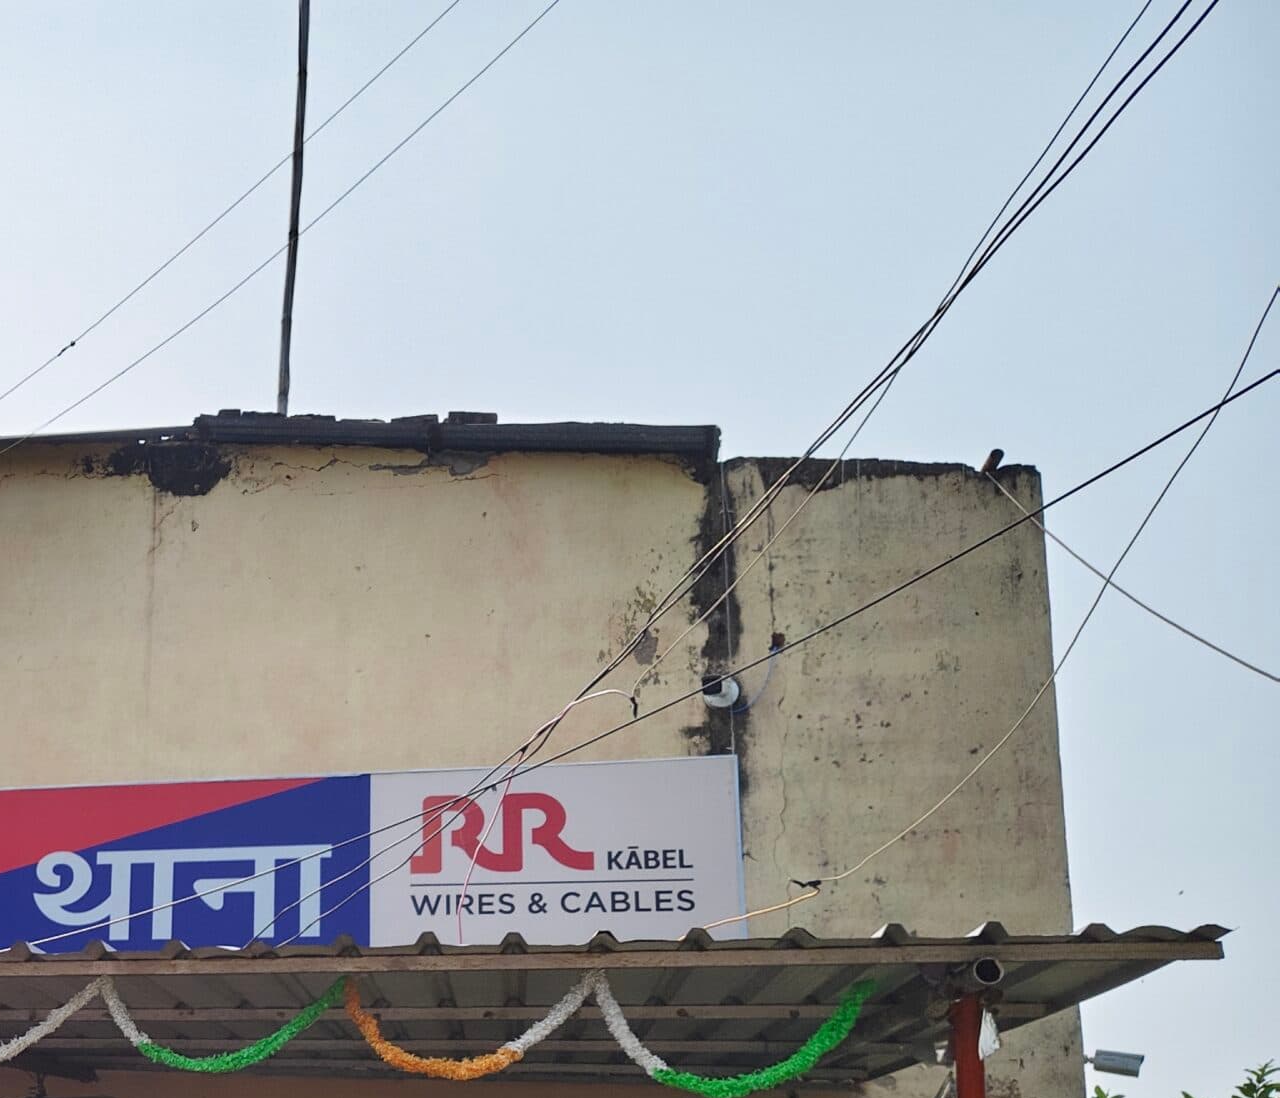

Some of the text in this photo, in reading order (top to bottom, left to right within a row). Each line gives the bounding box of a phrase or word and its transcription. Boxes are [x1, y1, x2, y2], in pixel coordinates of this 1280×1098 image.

[410, 792, 594, 874] RR
[607, 846, 694, 870] KĀBEL
[33, 844, 332, 944] थाना
[410, 889, 696, 916] WIRES & CABLES
